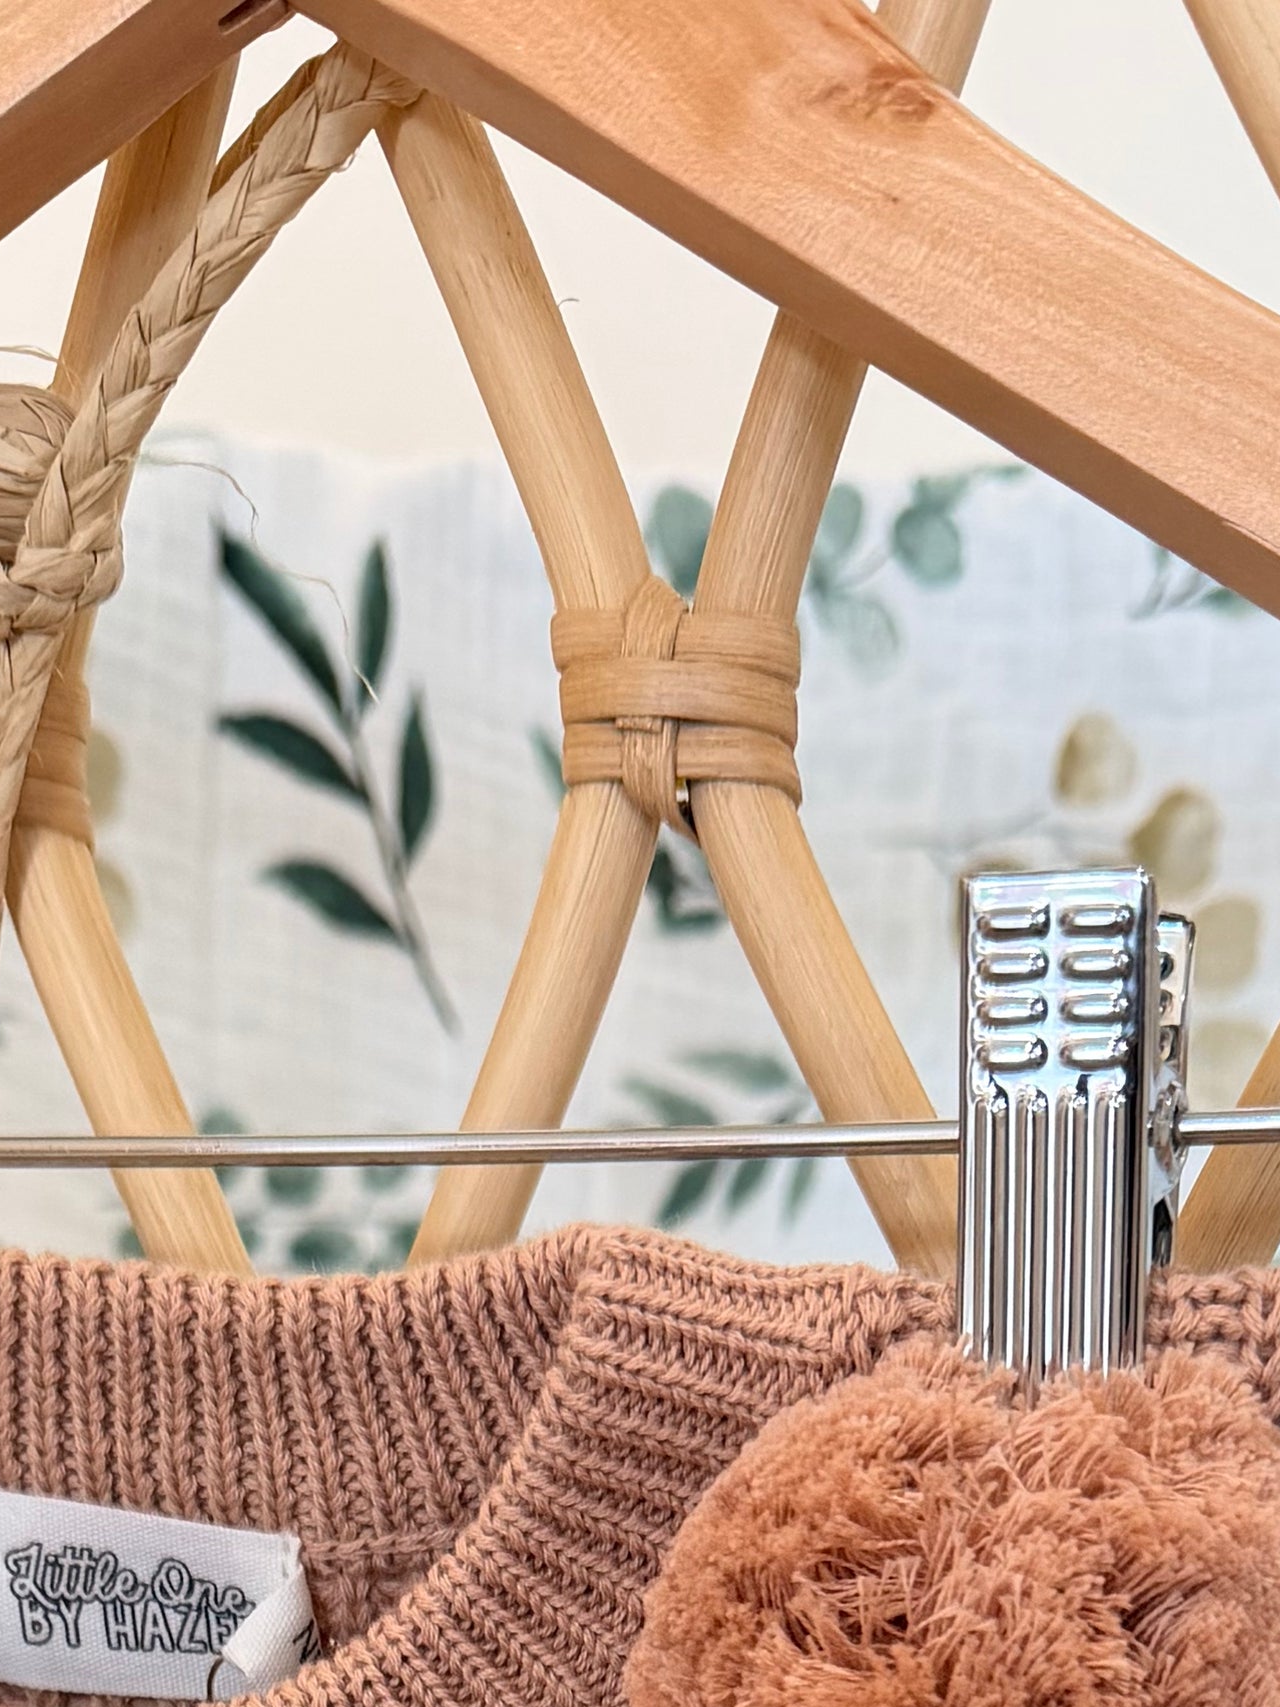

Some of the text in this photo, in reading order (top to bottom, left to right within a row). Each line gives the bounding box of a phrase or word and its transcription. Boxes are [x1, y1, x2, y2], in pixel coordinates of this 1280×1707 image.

[5, 1542, 148, 1604] Little
[19, 1599, 82, 1648] BY
[103, 1600, 239, 1655] HAZE
